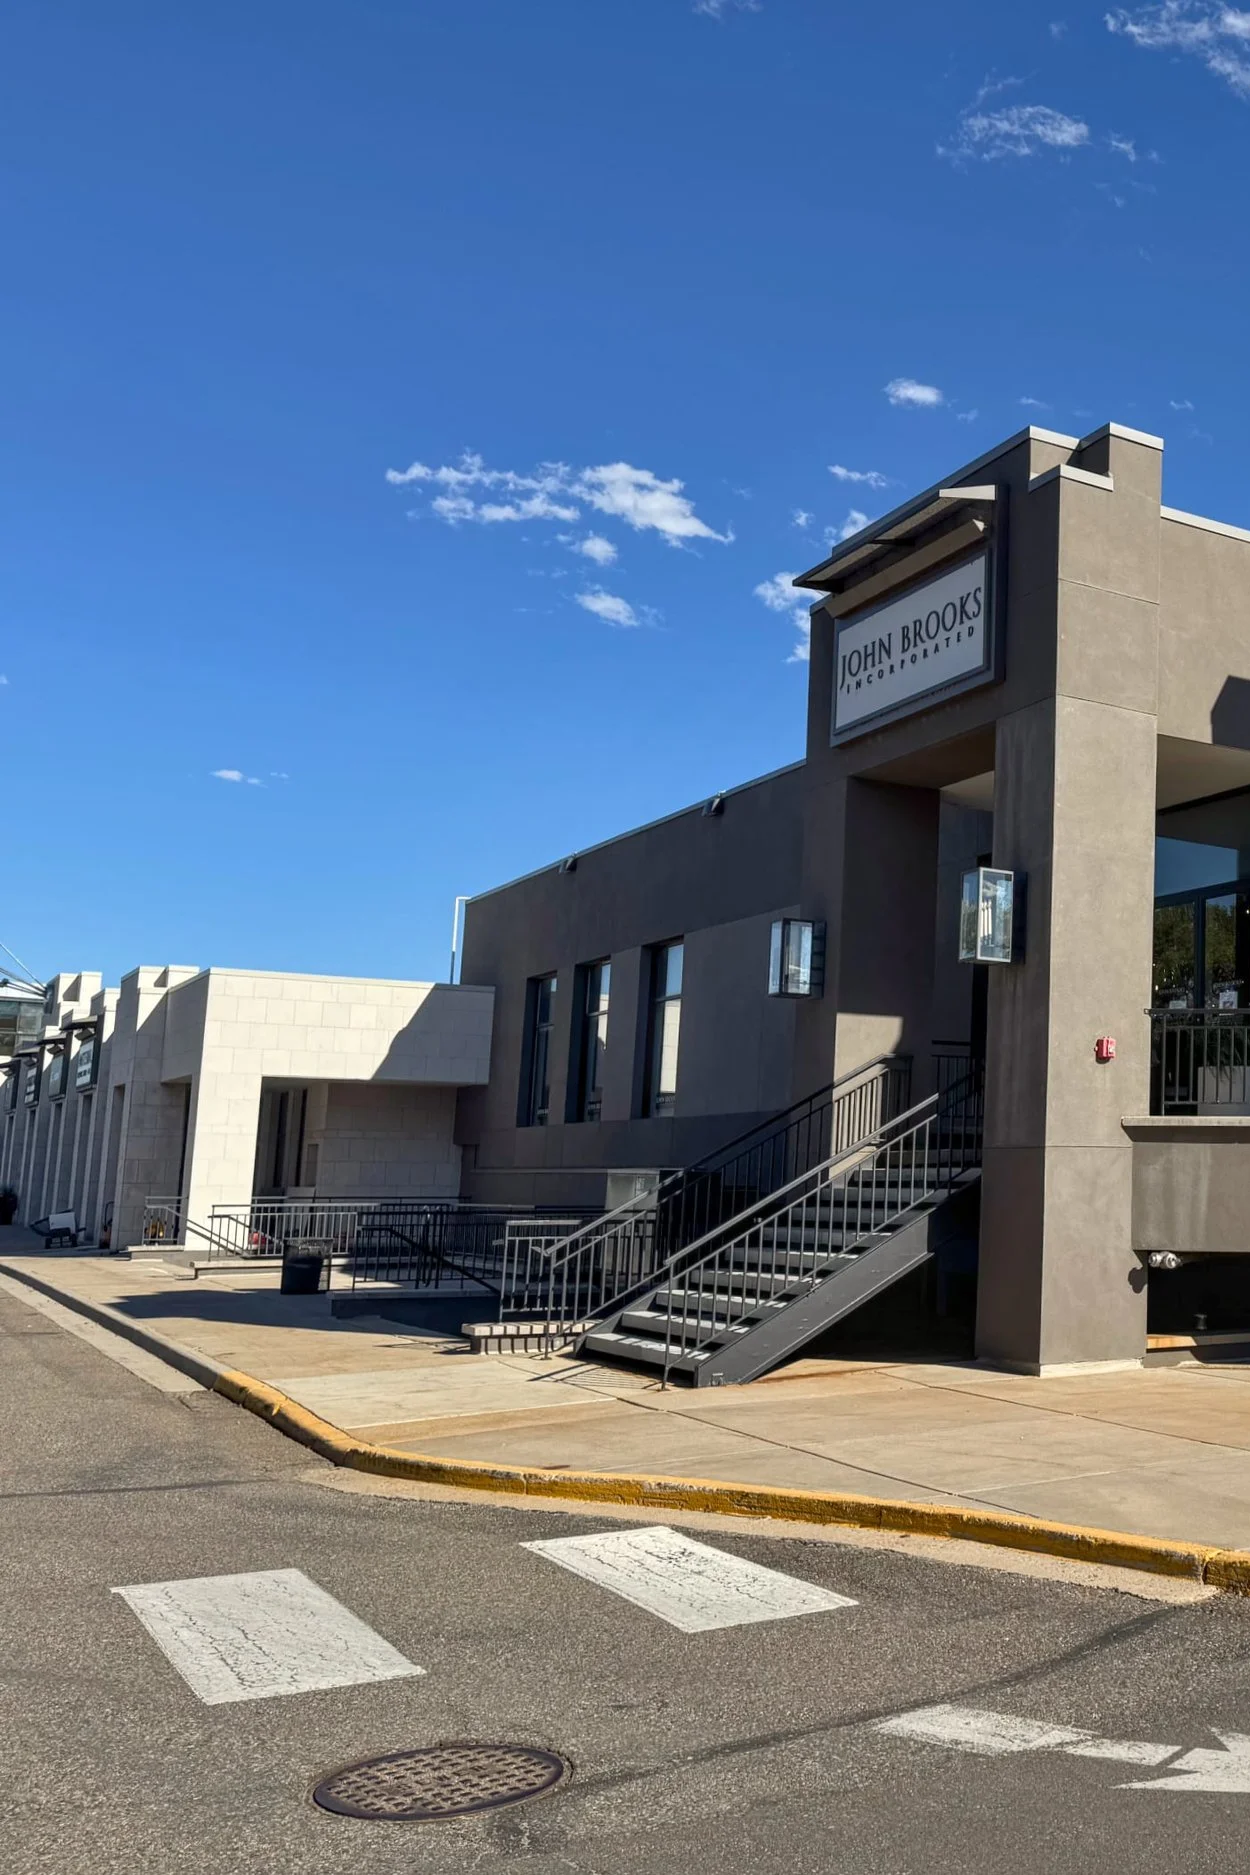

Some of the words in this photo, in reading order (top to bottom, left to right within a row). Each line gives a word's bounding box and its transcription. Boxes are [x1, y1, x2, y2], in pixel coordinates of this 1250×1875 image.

[839, 632, 892, 690] JOHN
[900, 586, 982, 653] BROOKS
[846, 625, 975, 694] INCORPORATED
